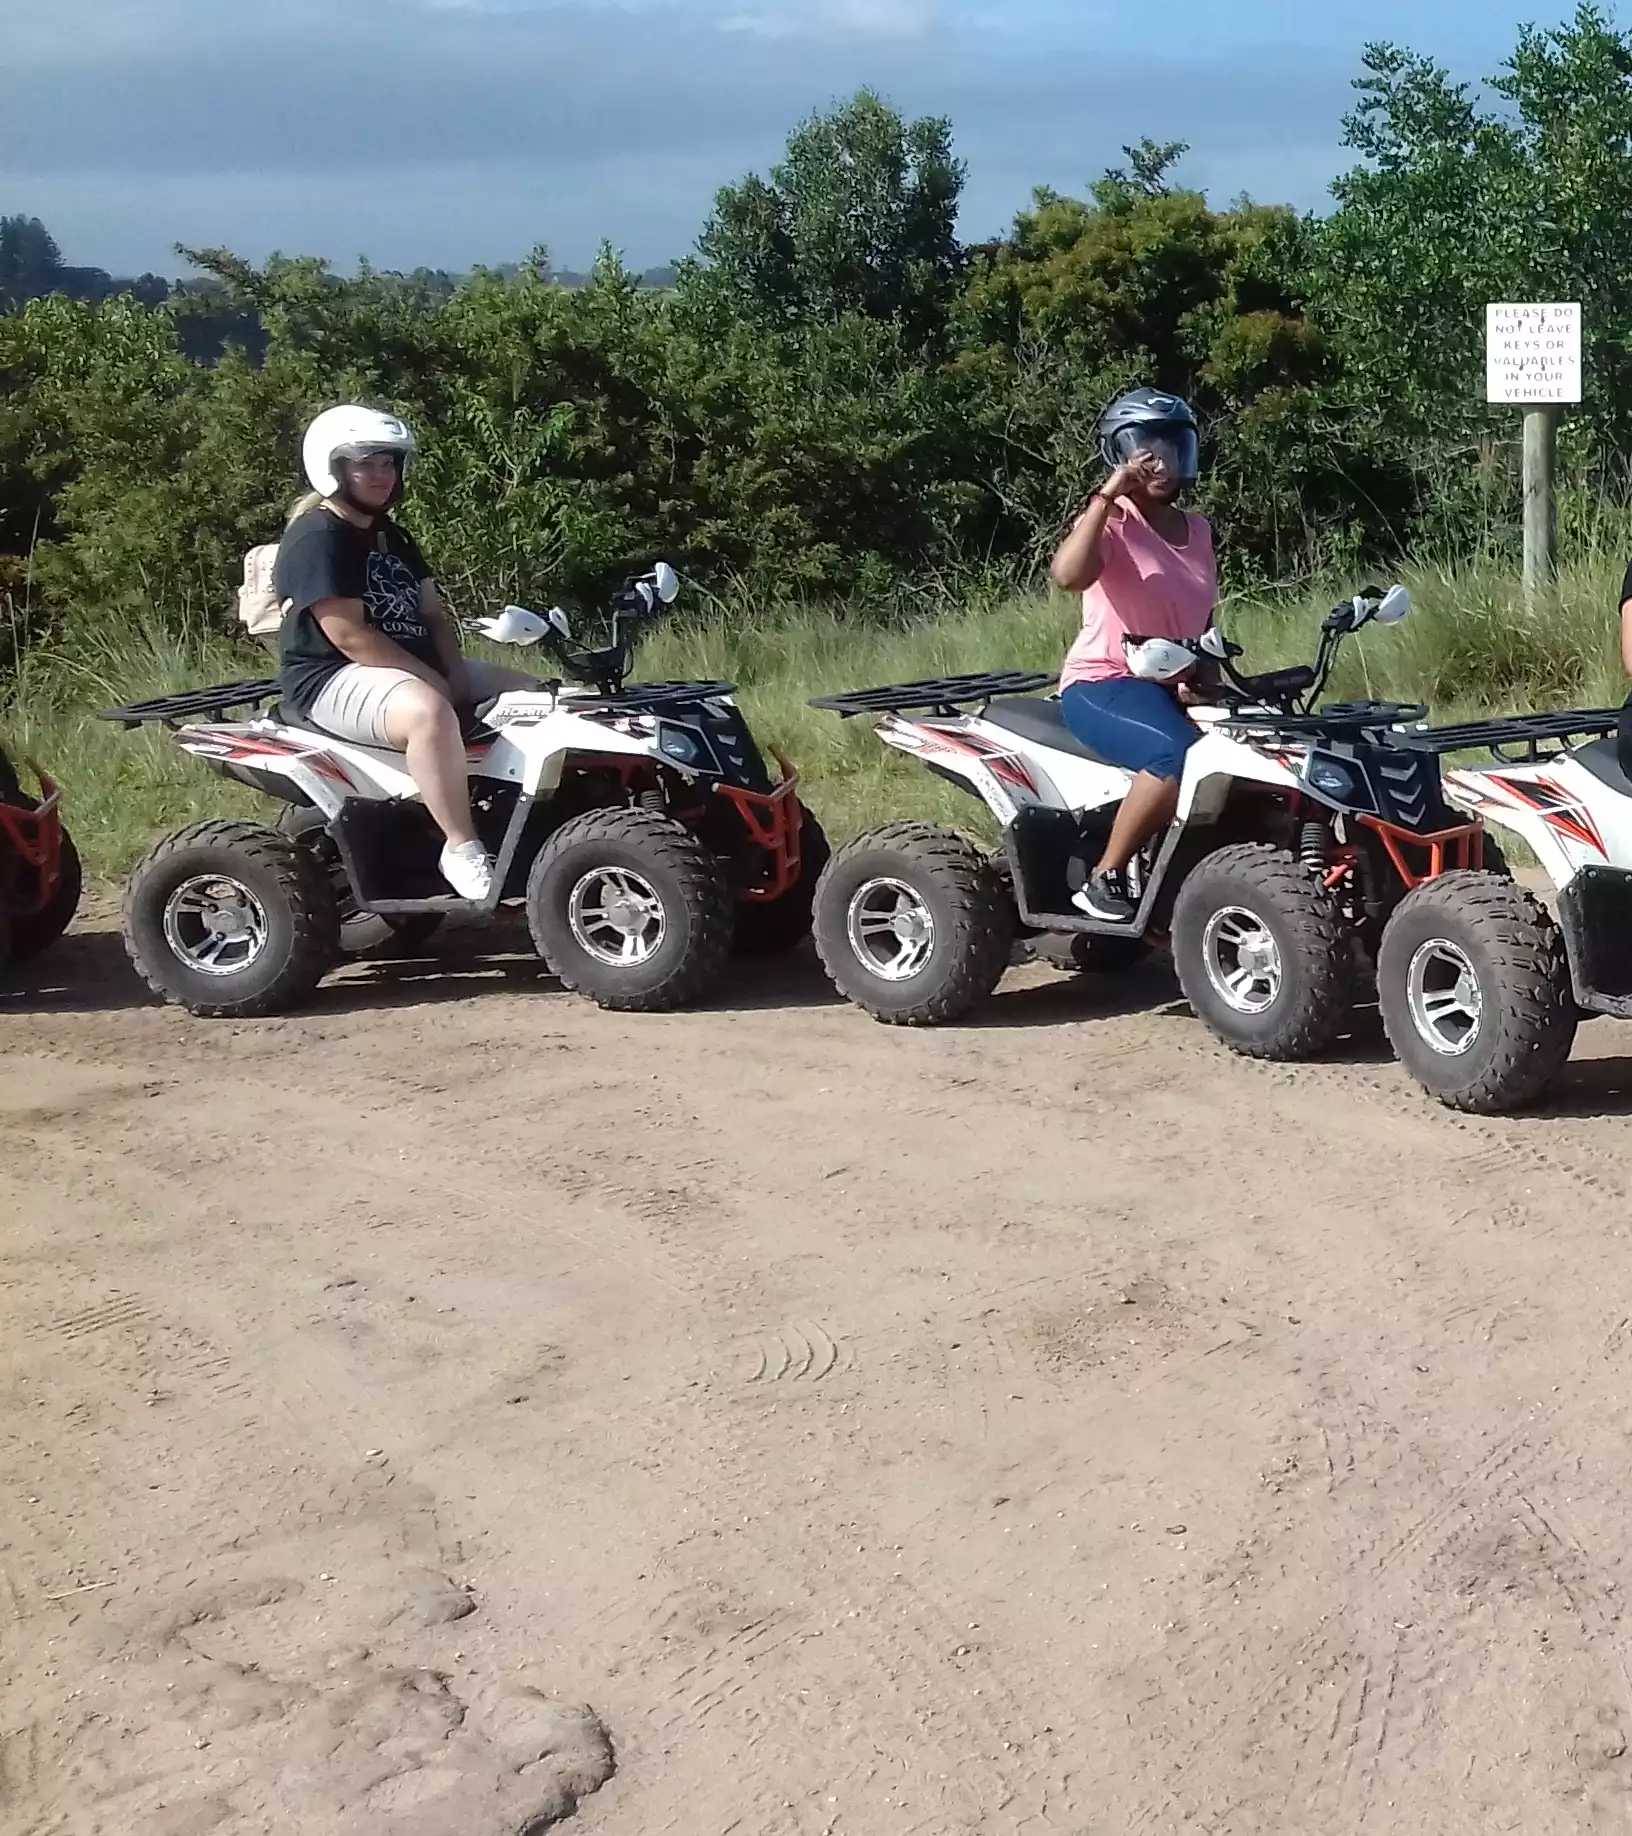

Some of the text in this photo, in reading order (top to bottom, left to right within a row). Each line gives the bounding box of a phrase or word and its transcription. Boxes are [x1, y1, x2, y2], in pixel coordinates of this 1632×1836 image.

[1495, 308, 1573, 318] PLEASE DO
[1495, 323, 1571, 334] NOT LEAVE
[1504, 340, 1564, 349] KEYS OR
[1494, 356, 1575, 366] VALUABLES
[1505, 372, 1563, 381] IN YOUR
[1505, 388, 1564, 397] VEHICLE
